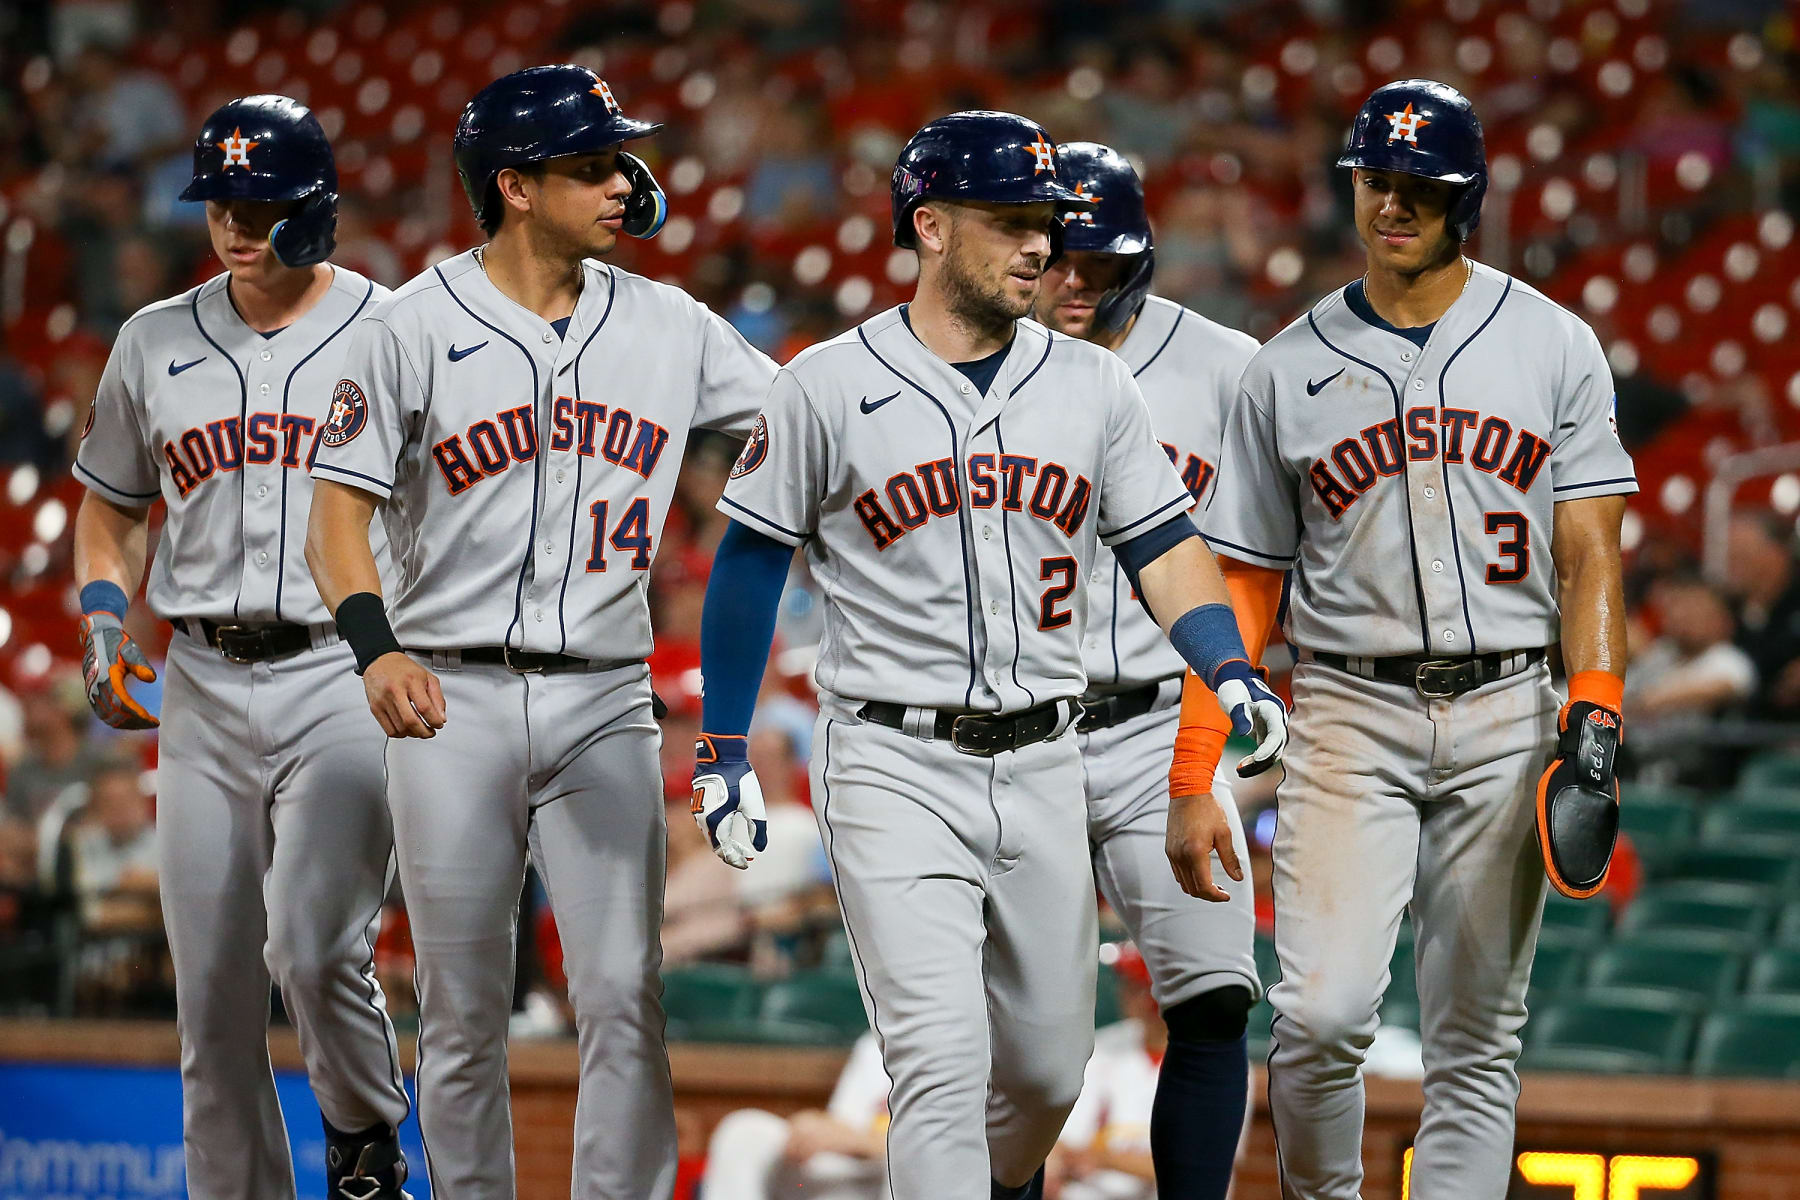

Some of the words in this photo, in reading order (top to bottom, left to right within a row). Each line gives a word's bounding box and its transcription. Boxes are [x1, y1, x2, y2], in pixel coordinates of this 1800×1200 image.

[223, 137, 250, 165] H
[1031, 142, 1056, 170] H
[1389, 111, 1422, 142] H
[433, 396, 670, 496] HOUSTON
[1309, 406, 1552, 521] HOUSTON
[586, 497, 652, 573] 14
[854, 453, 1093, 552] HOUSTON
[1484, 511, 1530, 584] 3
[1037, 556, 1078, 632] 2
[0, 1130, 184, 1193] ommu
